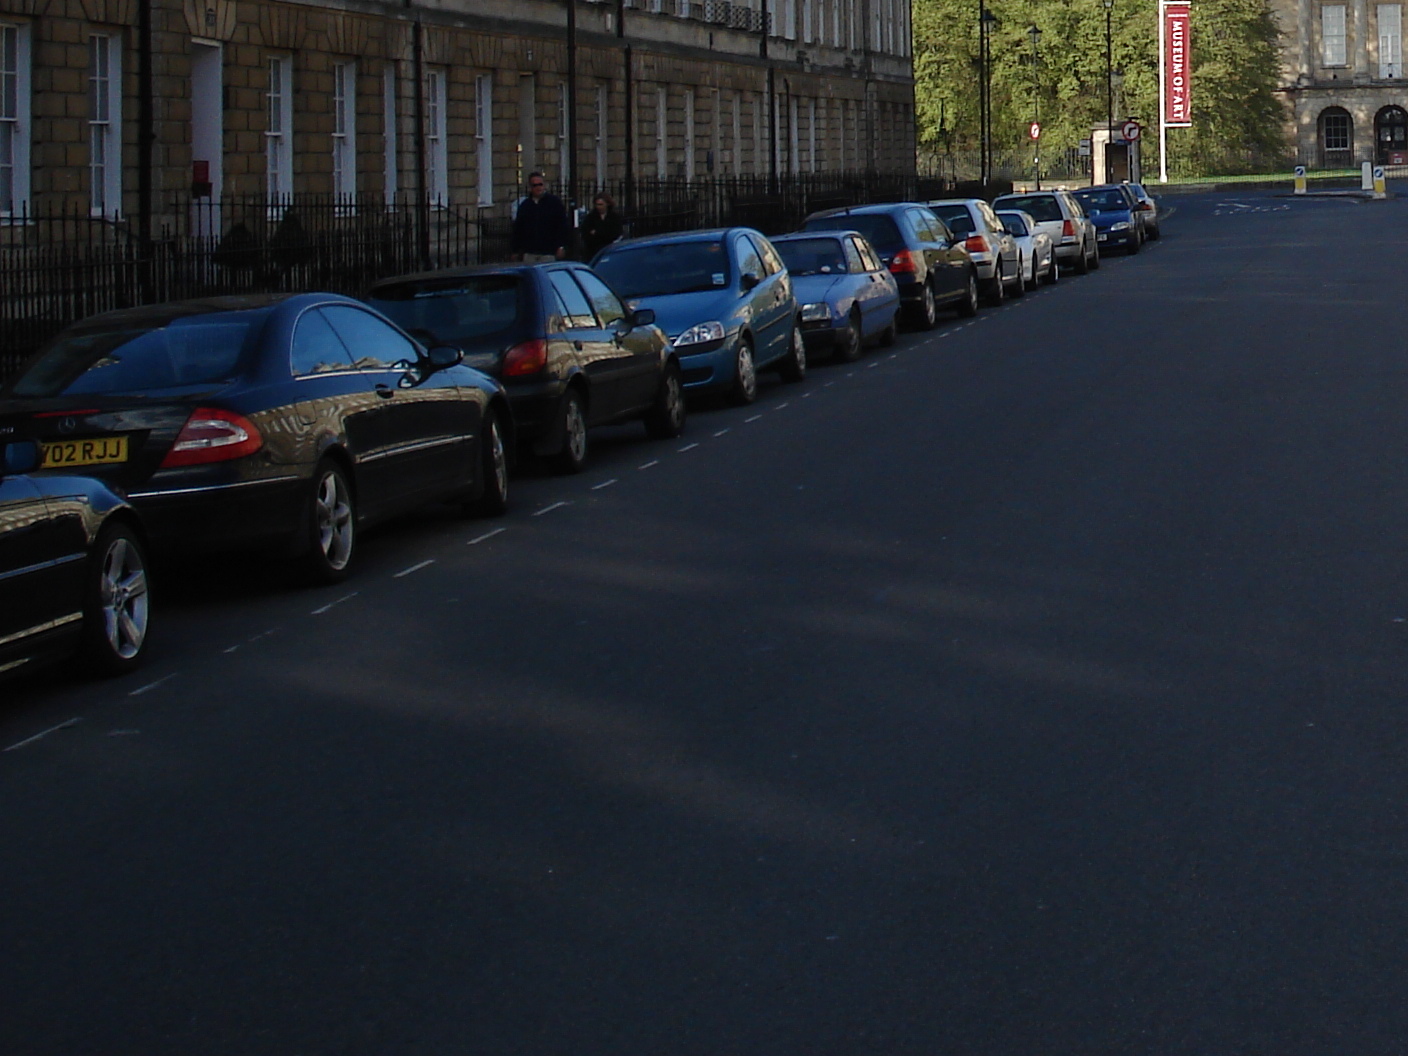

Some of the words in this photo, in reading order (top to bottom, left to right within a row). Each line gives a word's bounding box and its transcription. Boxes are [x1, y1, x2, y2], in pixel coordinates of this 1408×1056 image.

[1173, 21, 1183, 73] MUSEUM
[1173, 76, 1183, 95] OF
[1173, 97, 1184, 119] ART
[82, 440, 121, 461] RJJ
